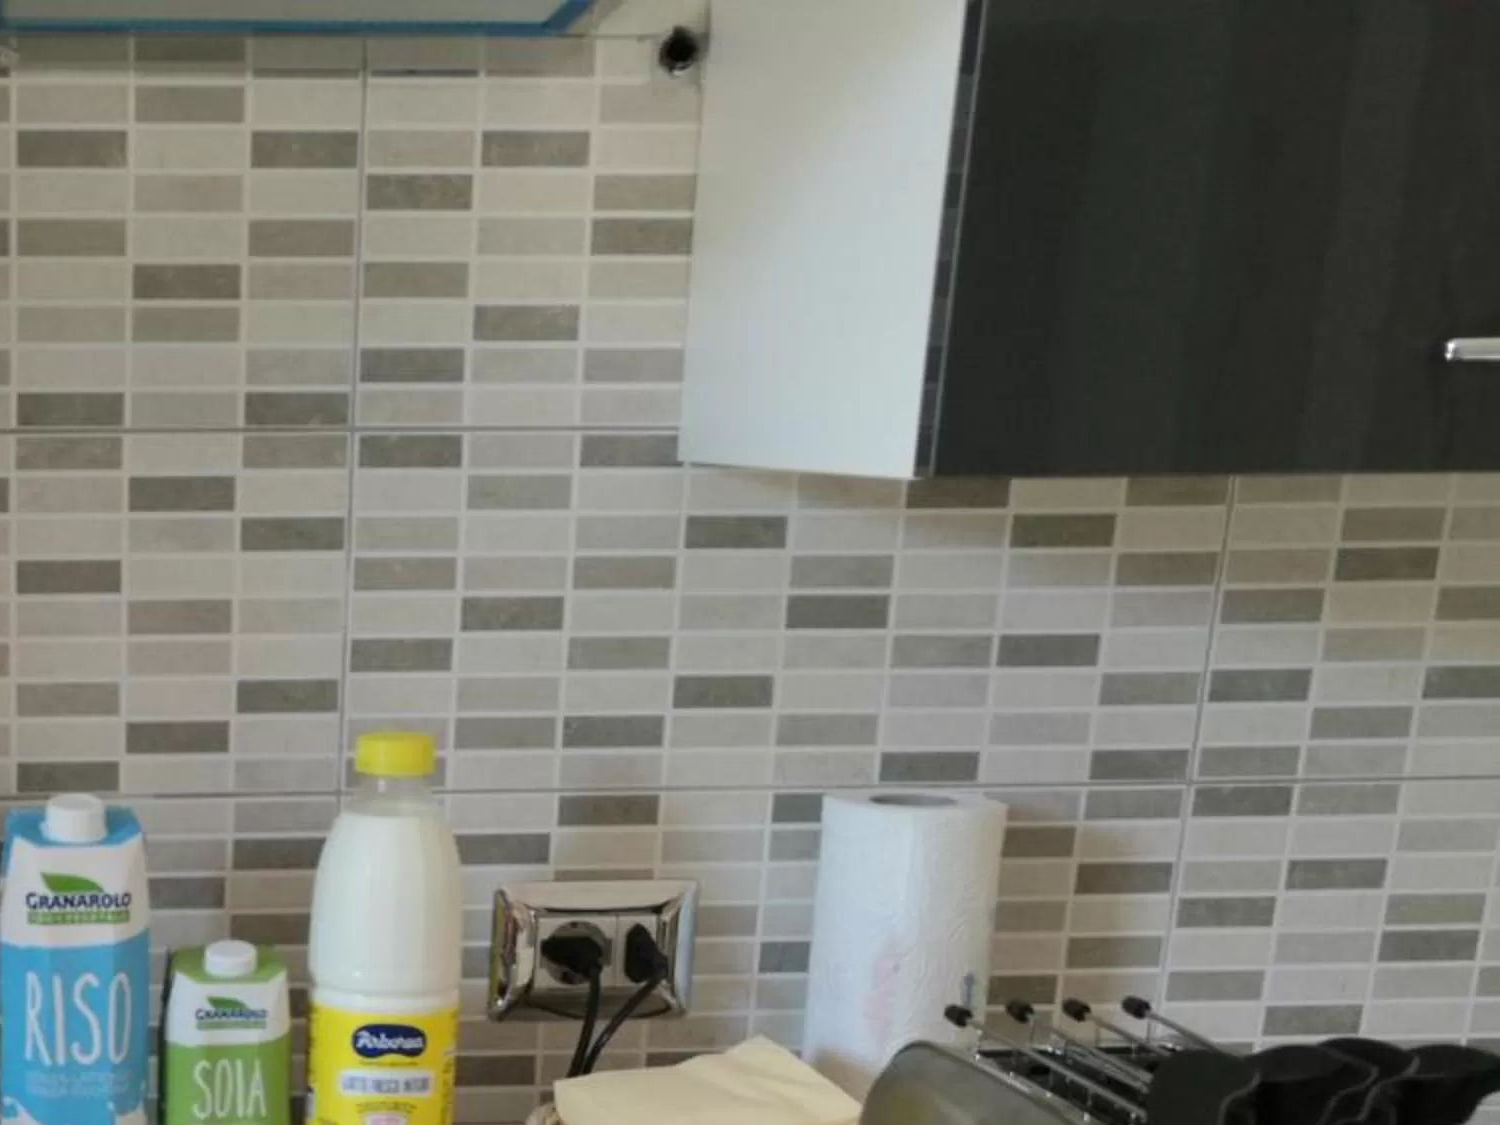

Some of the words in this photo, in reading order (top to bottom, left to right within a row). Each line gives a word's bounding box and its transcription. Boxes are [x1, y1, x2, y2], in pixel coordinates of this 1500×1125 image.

[26, 892, 132, 910] GRANAROLO
[25, 971, 132, 1066] RISO
[192, 1057, 267, 1120] SOIA
